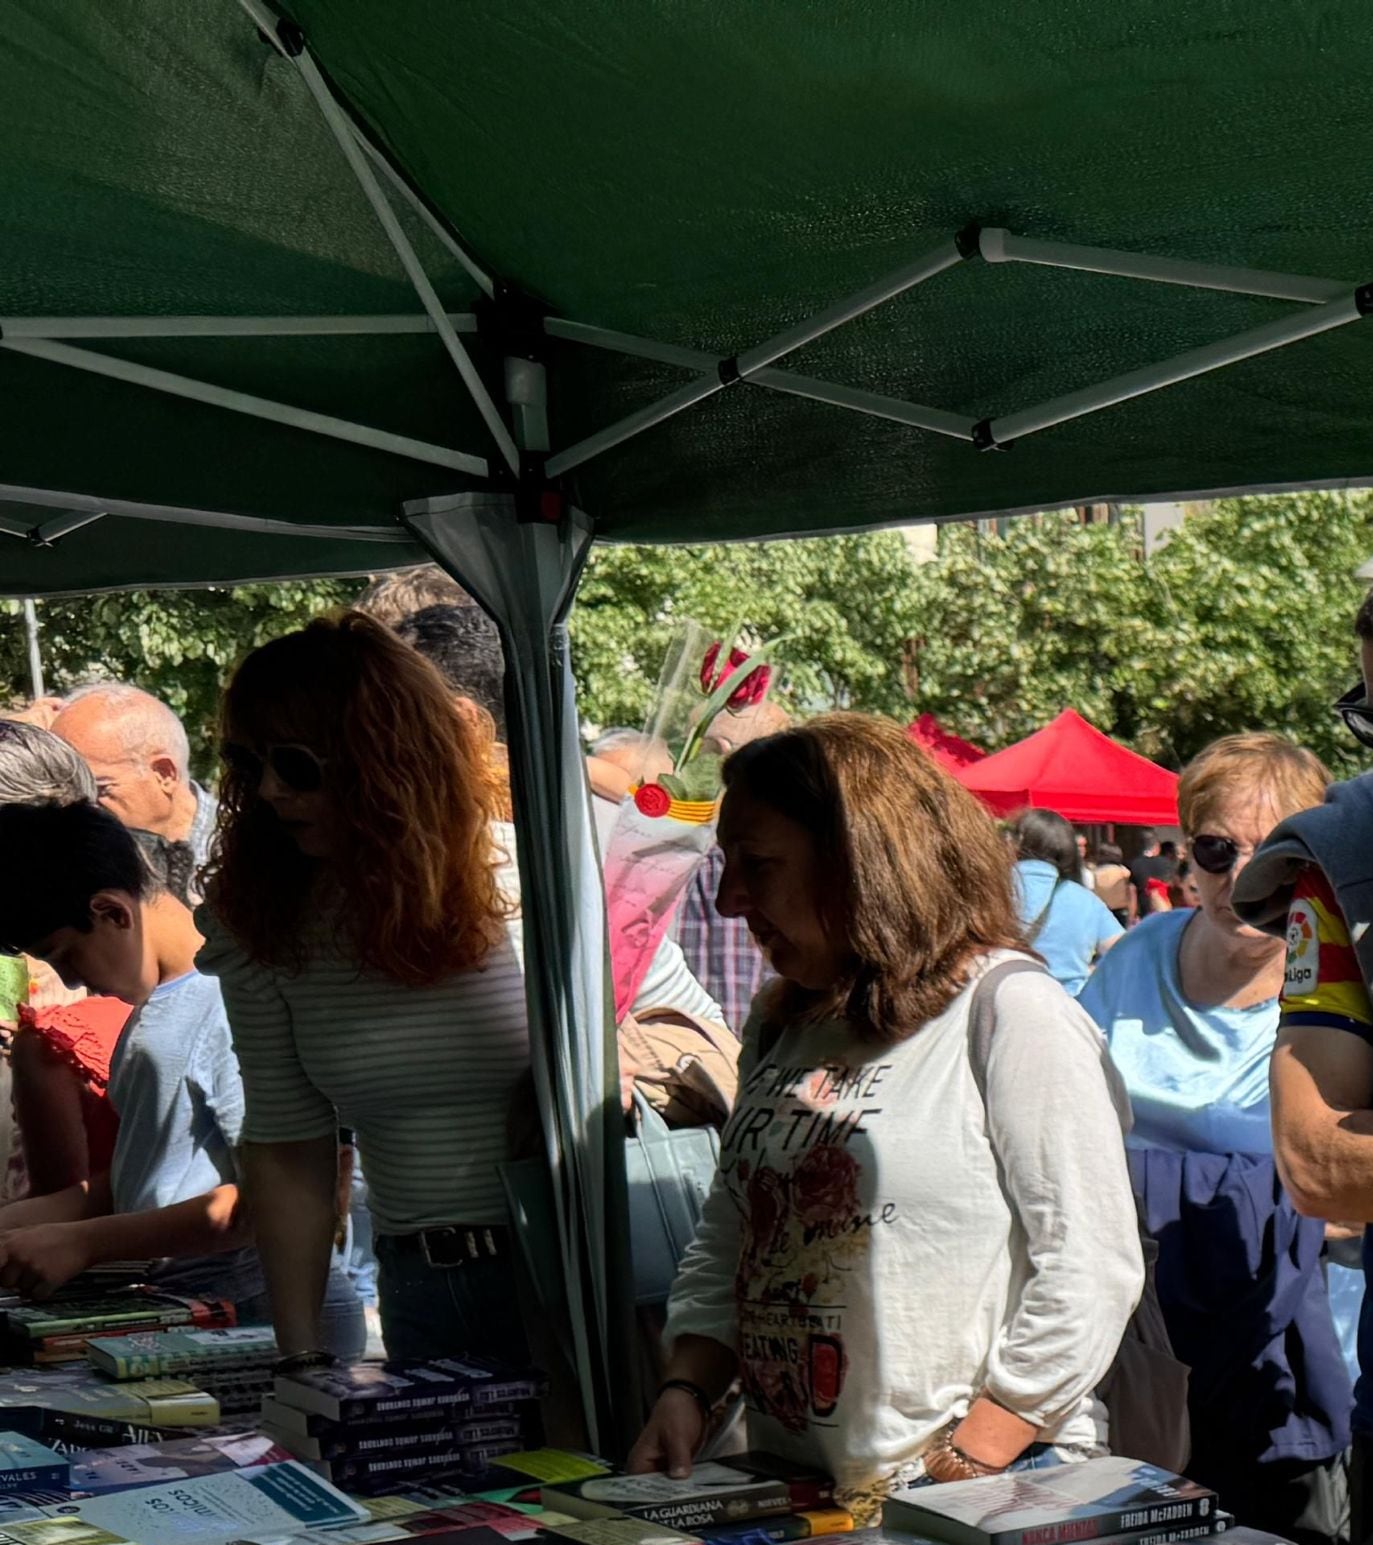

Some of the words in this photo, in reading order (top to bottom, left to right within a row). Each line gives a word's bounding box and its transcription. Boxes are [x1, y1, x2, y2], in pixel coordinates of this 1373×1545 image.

[813, 1064, 893, 1100] TAKE
[659, 1500, 723, 1519] GUARDIANA
[686, 1513, 714, 1526] ROSA
[1150, 1502, 1193, 1525] McFADDEN
